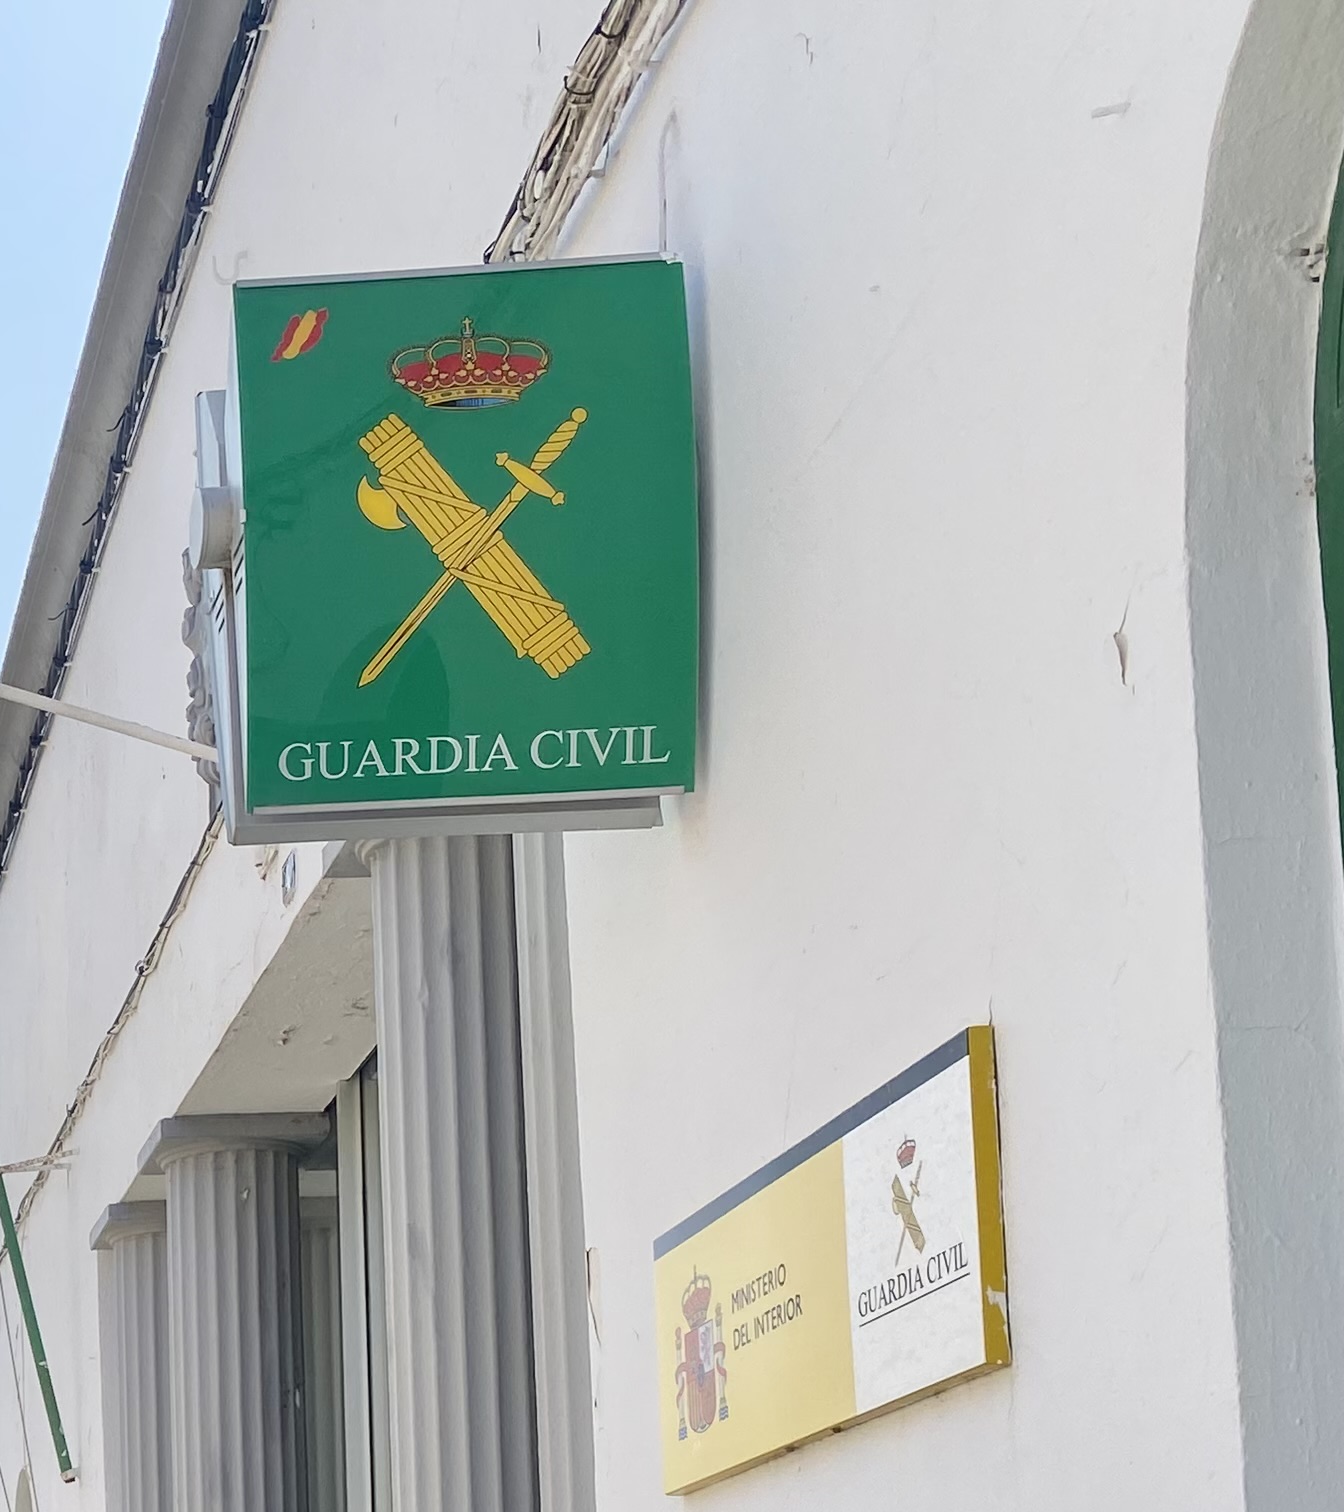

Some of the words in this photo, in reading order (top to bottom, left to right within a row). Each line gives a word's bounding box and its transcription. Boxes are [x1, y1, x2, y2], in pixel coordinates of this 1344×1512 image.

[278, 733, 519, 782] GUARDIA
[529, 726, 671, 770] CIVIL
[731, 1263, 787, 1314] MINISTERIO
[857, 1264, 924, 1317] GUARDIA
[926, 1241, 968, 1285] CIVIL
[732, 1324, 751, 1351] DEL
[753, 1293, 803, 1340] INTERIOR
